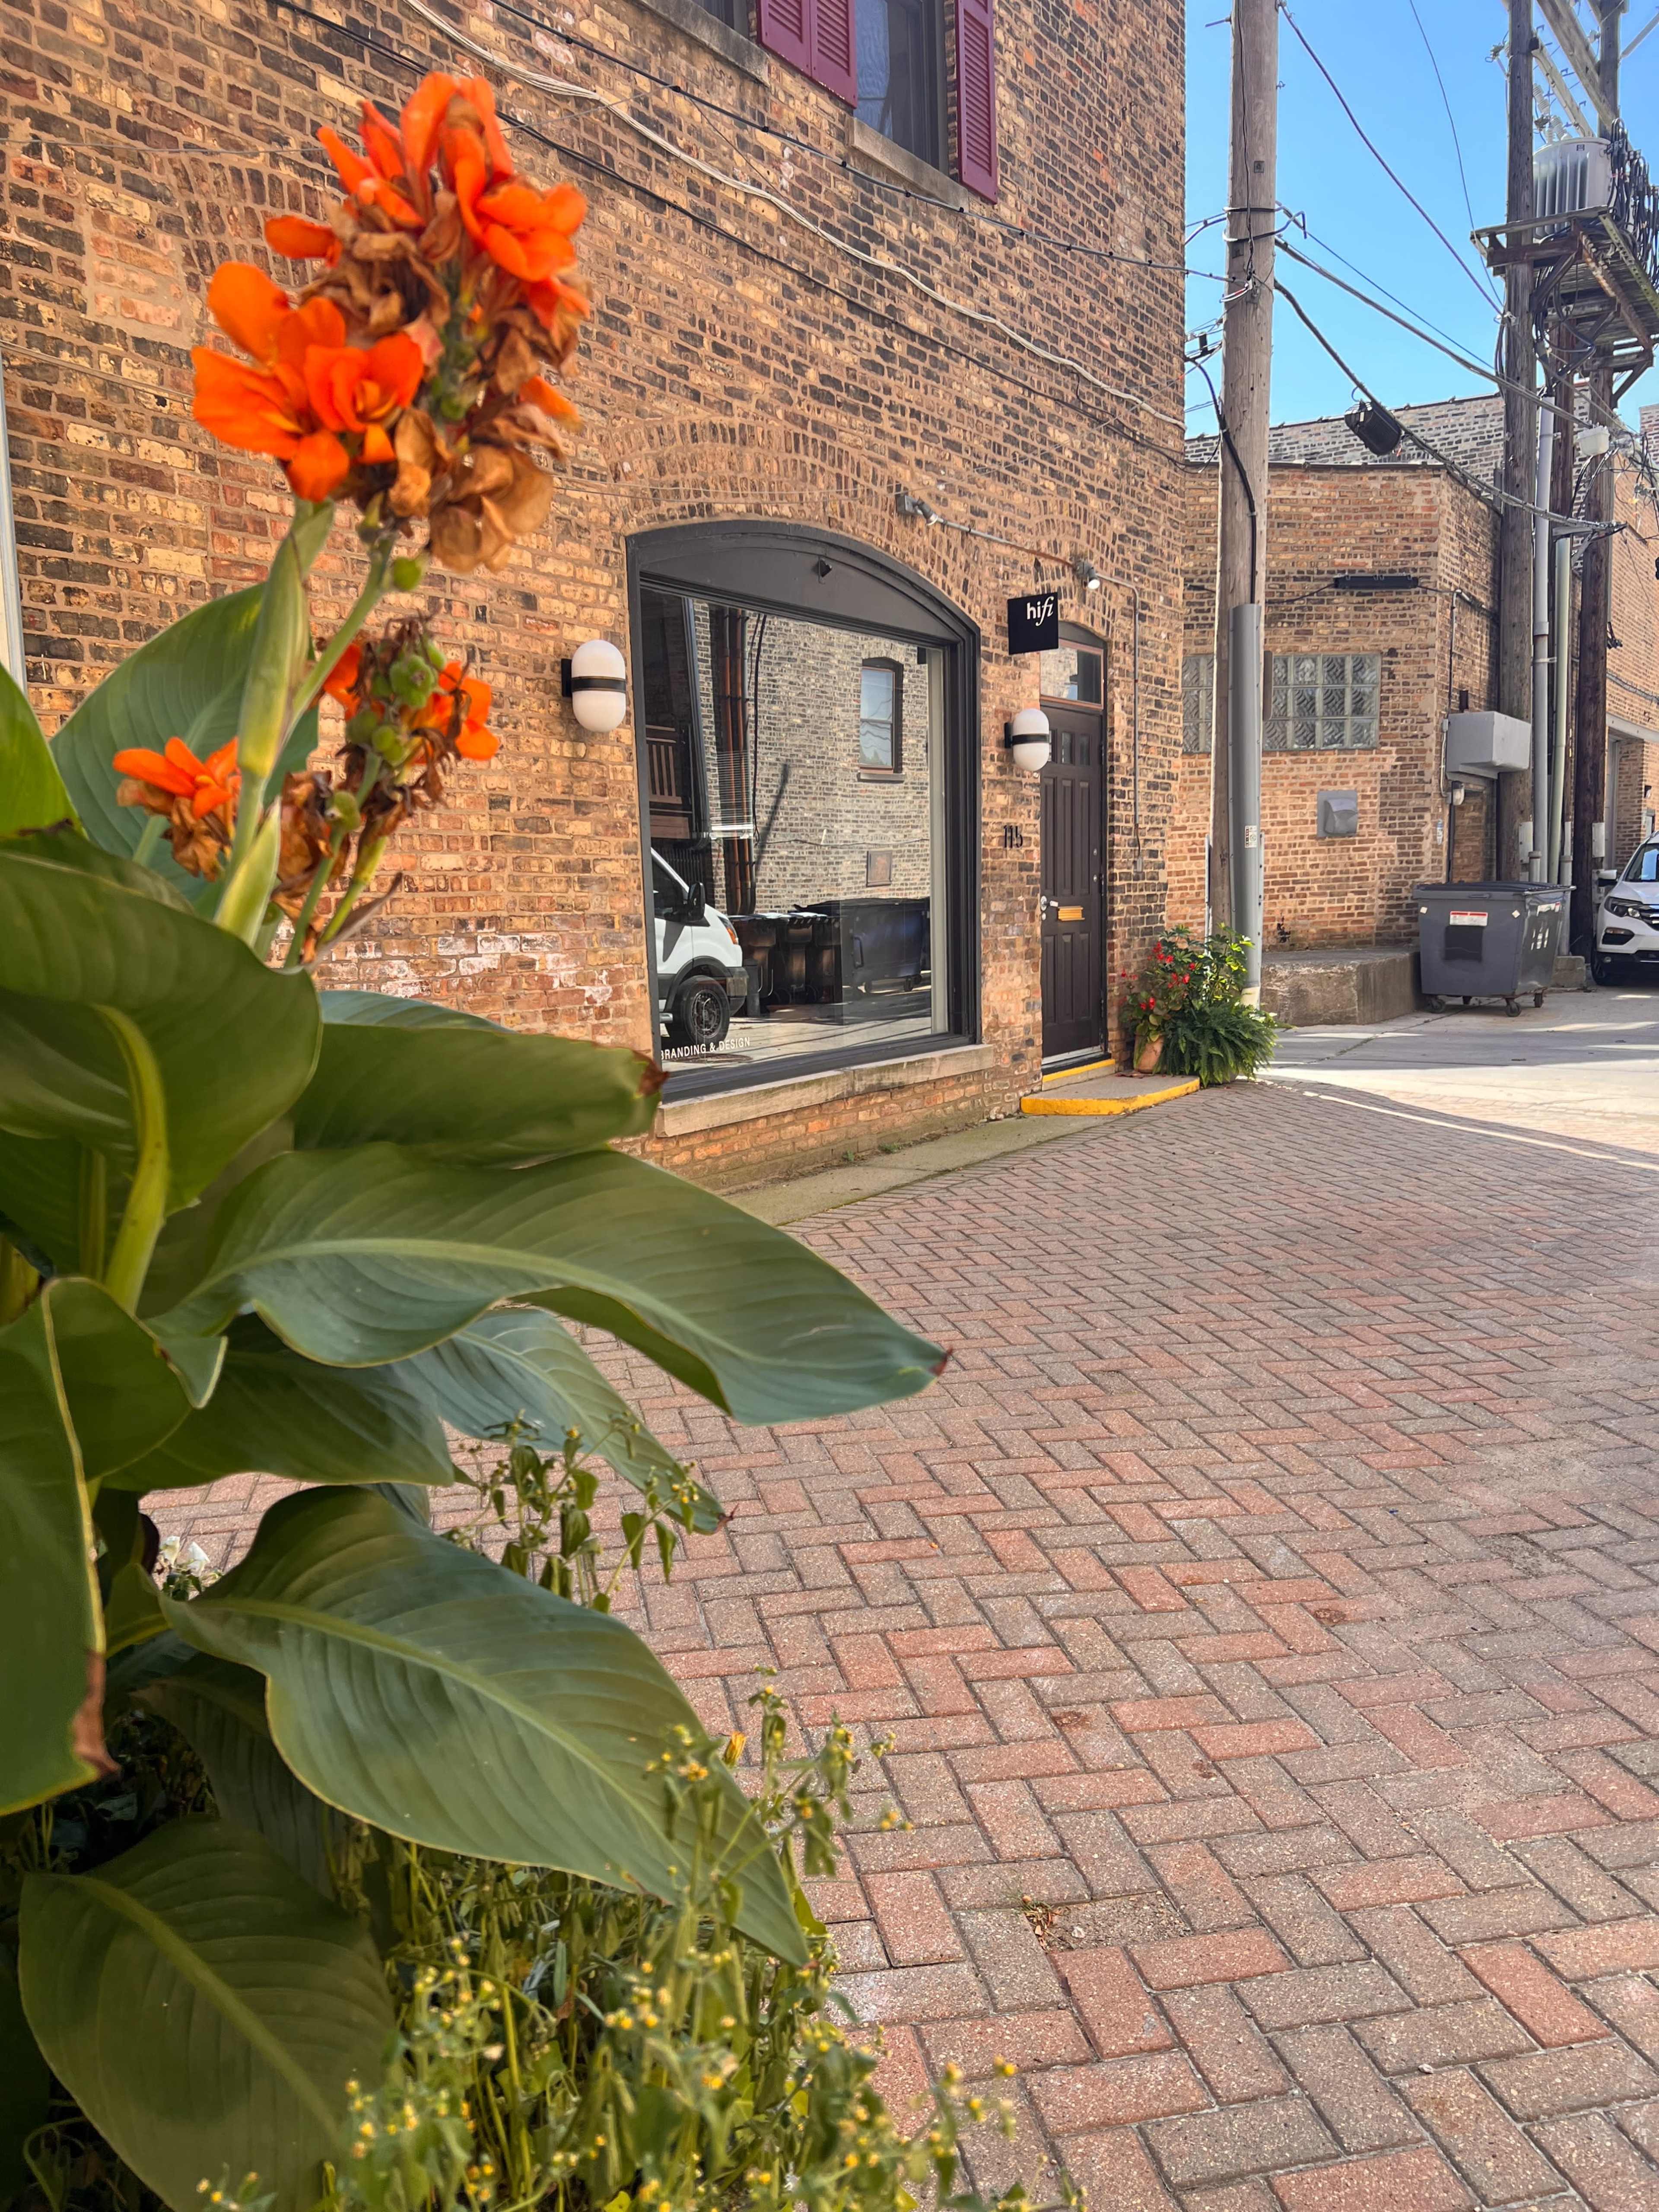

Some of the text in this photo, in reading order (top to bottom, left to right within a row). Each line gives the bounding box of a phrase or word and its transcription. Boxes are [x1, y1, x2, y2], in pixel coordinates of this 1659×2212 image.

[1027, 596, 1054, 626] hifi
[1004, 825, 1023, 849] 115
[709, 1042, 716, 1052] &
[719, 1036, 750, 1051] DESIGN
